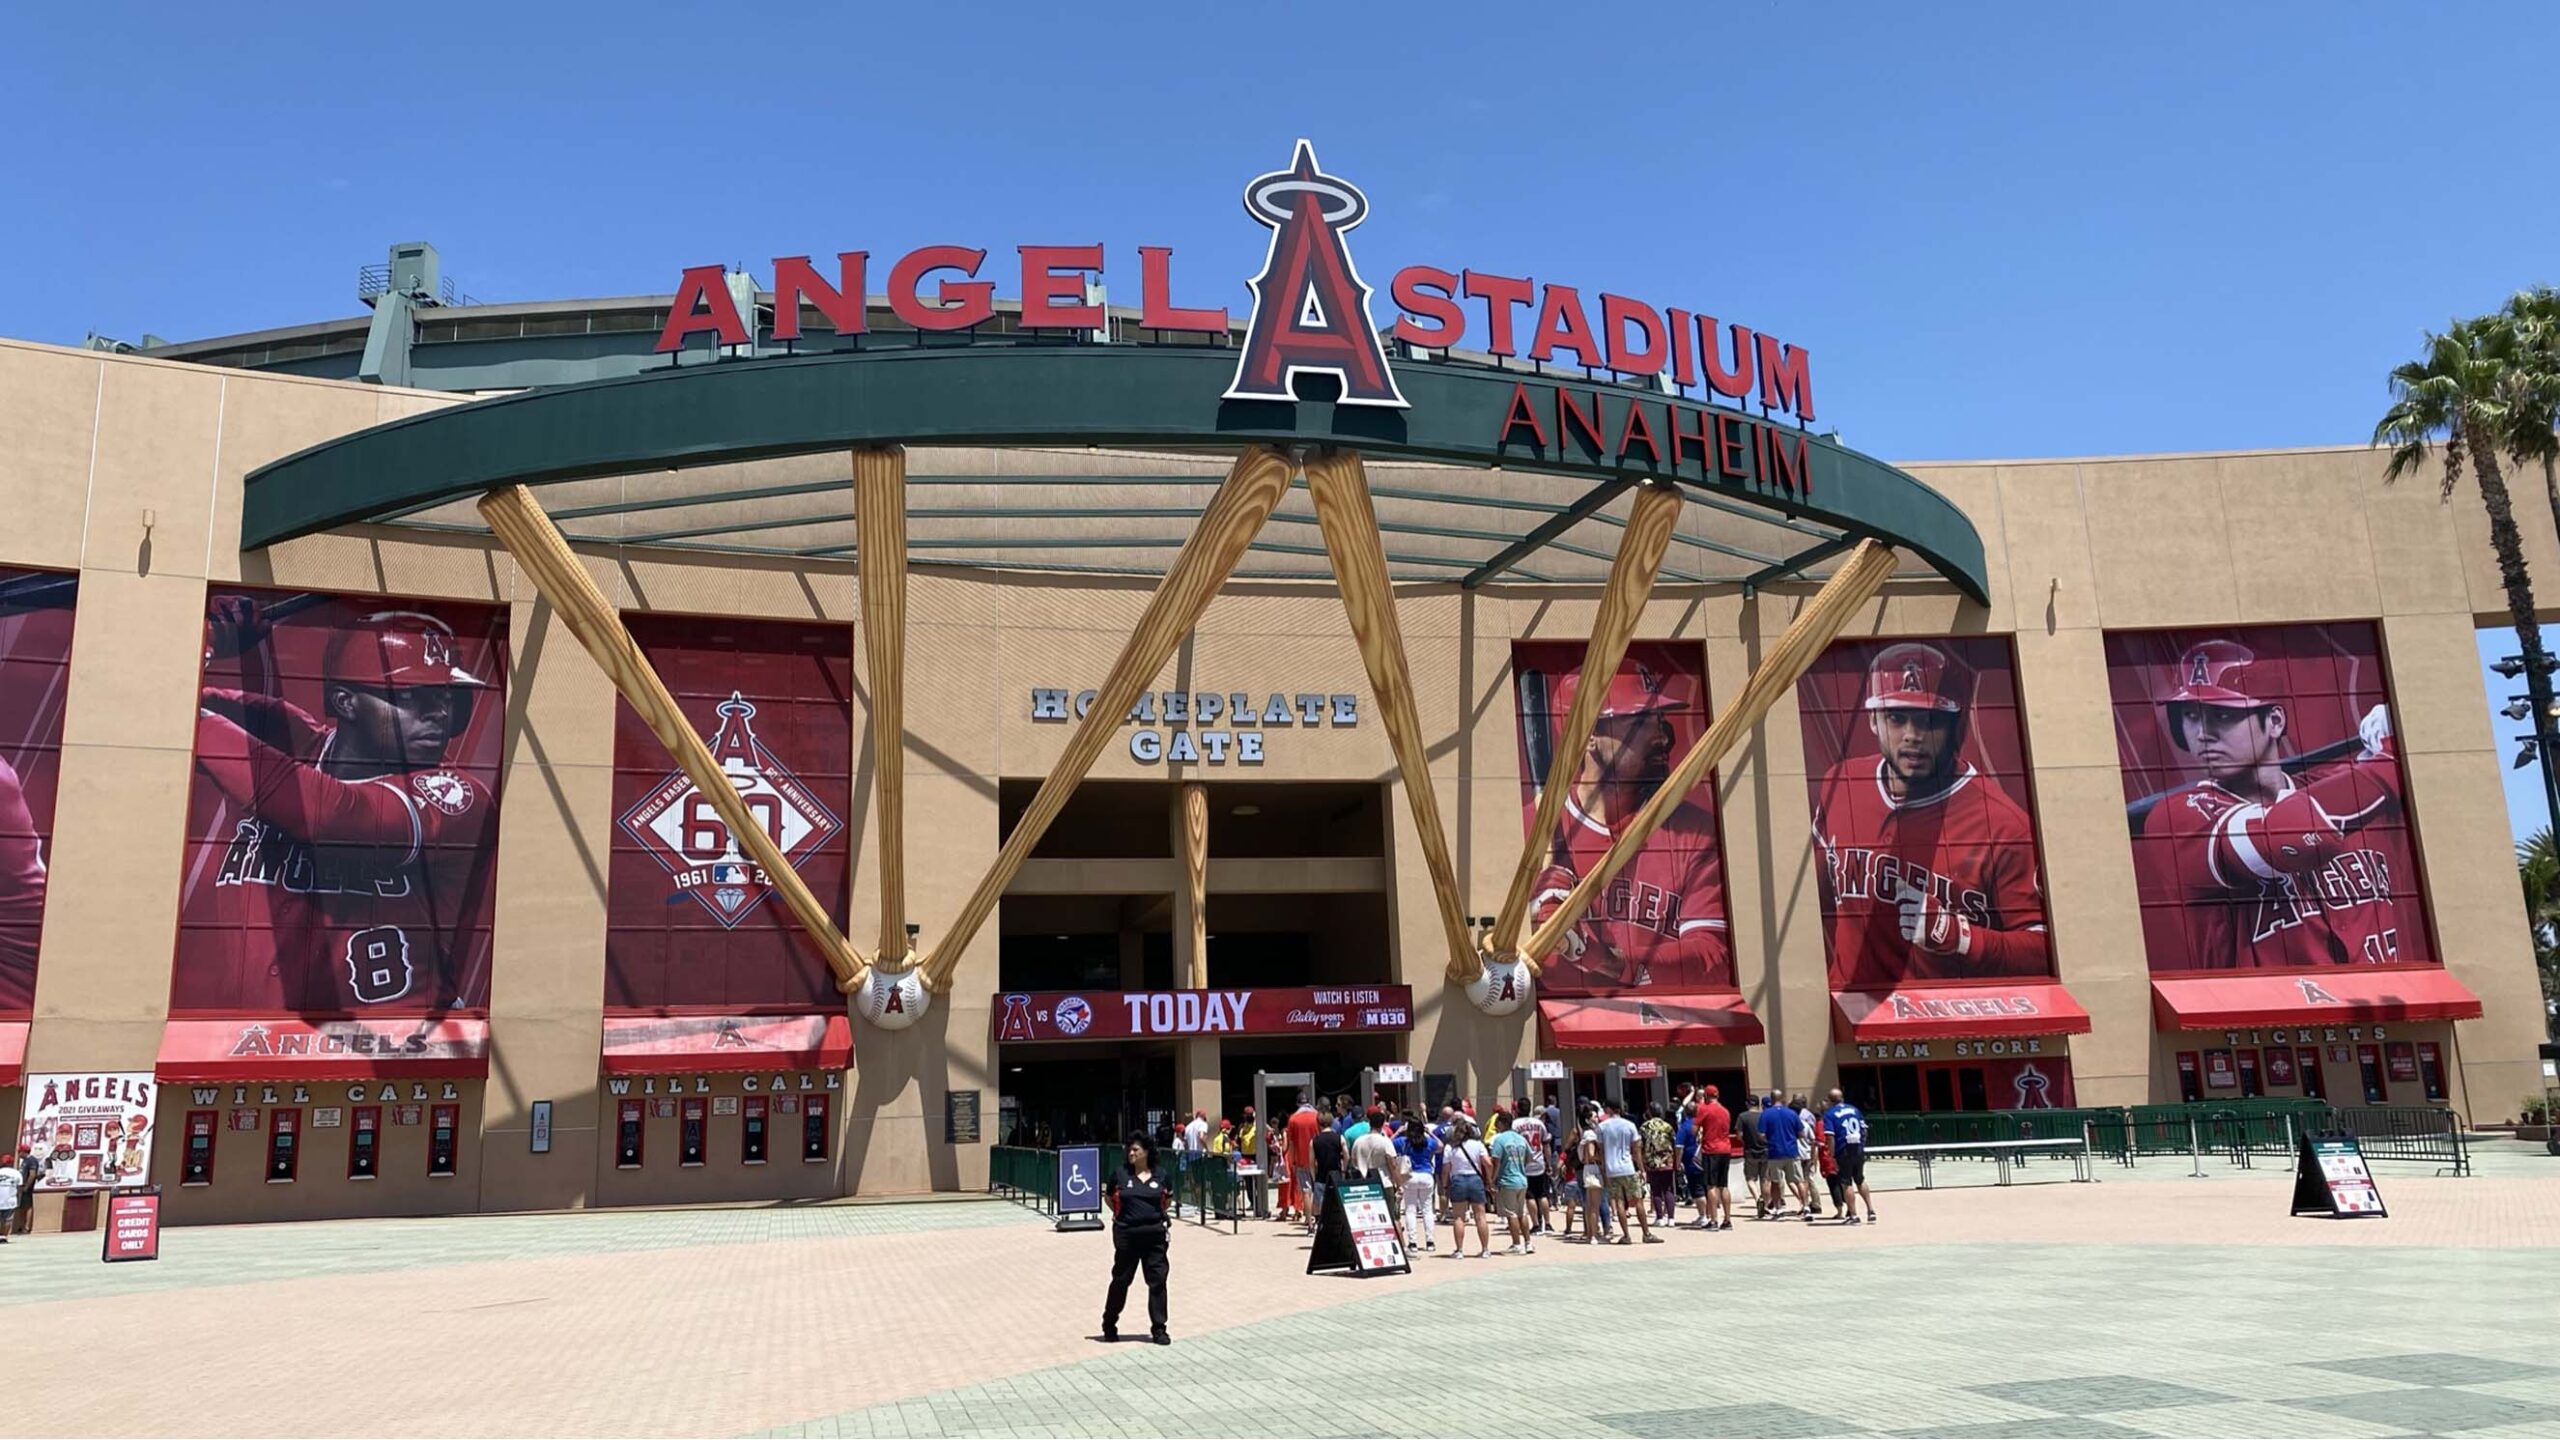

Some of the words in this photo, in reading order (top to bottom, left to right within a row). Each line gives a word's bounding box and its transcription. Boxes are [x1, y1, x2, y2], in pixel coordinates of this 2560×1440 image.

[653, 241, 1229, 354] ANGEL
[1220, 138, 1412, 409] A
[1391, 265, 1815, 423] STADIUM
[1500, 381, 1813, 497] ANAHEIM
[1032, 688, 1357, 726] HOMEPLATE
[1130, 730, 1265, 765] GATE
[631, 798, 665, 829] ANGELS
[780, 782, 833, 832] ANNIVERSARY
[673, 869, 708, 889] 1961
[345, 925, 414, 1003] 8
[1313, 991, 1341, 1005] WATCH
[1344, 991, 1351, 1004] &
[1352, 990, 1380, 1003] LISTEN
[1890, 993, 2037, 1021] ANGELS
[1036, 1010, 1048, 1022] VS
[1124, 991, 1251, 1033] TODAY
[1320, 1013, 1345, 1022] SPORTS
[1380, 1013, 1406, 1025] 830
[228, 1024, 428, 1056] ANGELS
[2226, 1026, 2386, 1045] TICKETS
[1859, 1044, 1930, 1059] TEAM
[1957, 1040, 2041, 1056] STORE
[38, 1078, 150, 1112] ANGELS
[192, 1087, 310, 1105] WILL
[347, 1083, 458, 1102] CALL
[608, 1077, 710, 1095] WILL
[742, 1074, 840, 1091] CALL
[58, 1105, 76, 1114] 2021
[78, 1105, 125, 1113] GIVEAWAYS
[118, 1217, 151, 1228] CREDIT
[118, 1229, 149, 1239] CARDS
[121, 1240, 145, 1251] ONLY
